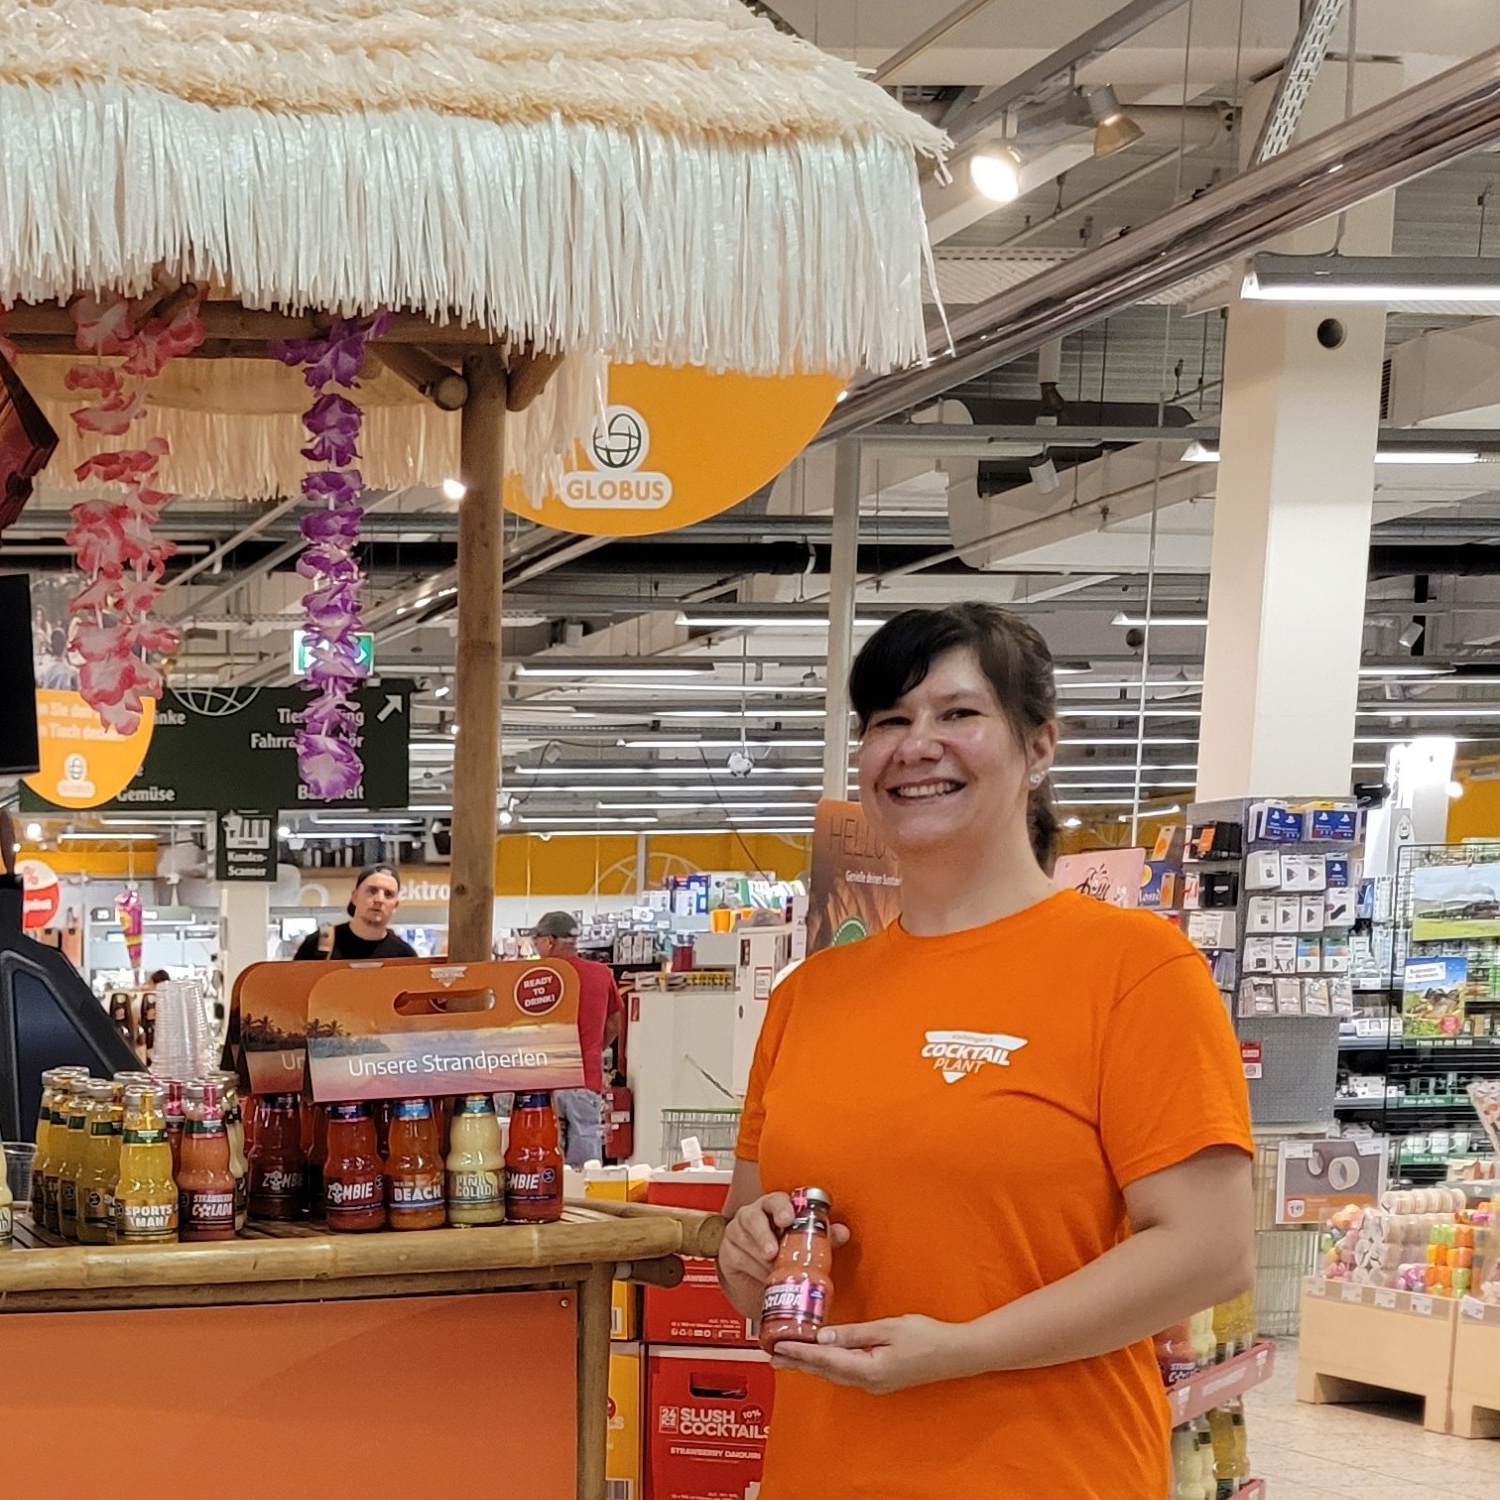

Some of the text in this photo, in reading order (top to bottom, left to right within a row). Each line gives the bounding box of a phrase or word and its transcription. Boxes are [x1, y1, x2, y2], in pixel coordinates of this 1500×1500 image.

[566, 479, 664, 501] GLOBUS
[116, 786, 175, 802] Gemüse
[227, 851, 267, 864] Kunden-
[227, 865, 267, 878] Scanner
[400, 881, 451, 901] ektro
[523, 975, 553, 989] READY
[532, 987, 546, 996] TO
[524, 994, 556, 1007] DRINK!
[921, 1043, 1011, 1066] COCKTAIL
[348, 1050, 548, 1078] Unsere Strandperlen
[932, 1057, 987, 1074] PLANT
[505, 1171, 541, 1190] MBIE
[327, 1181, 374, 1205] ZOMBIE
[394, 1184, 442, 1201] BEACH
[125, 1204, 173, 1217] SPORTS
[680, 1408, 736, 1424] SLUSH
[742, 1409, 761, 1419] 10%
[680, 1421, 771, 1439] COCKTAILS
[670, 1446, 724, 1457] STRAWBERRY
